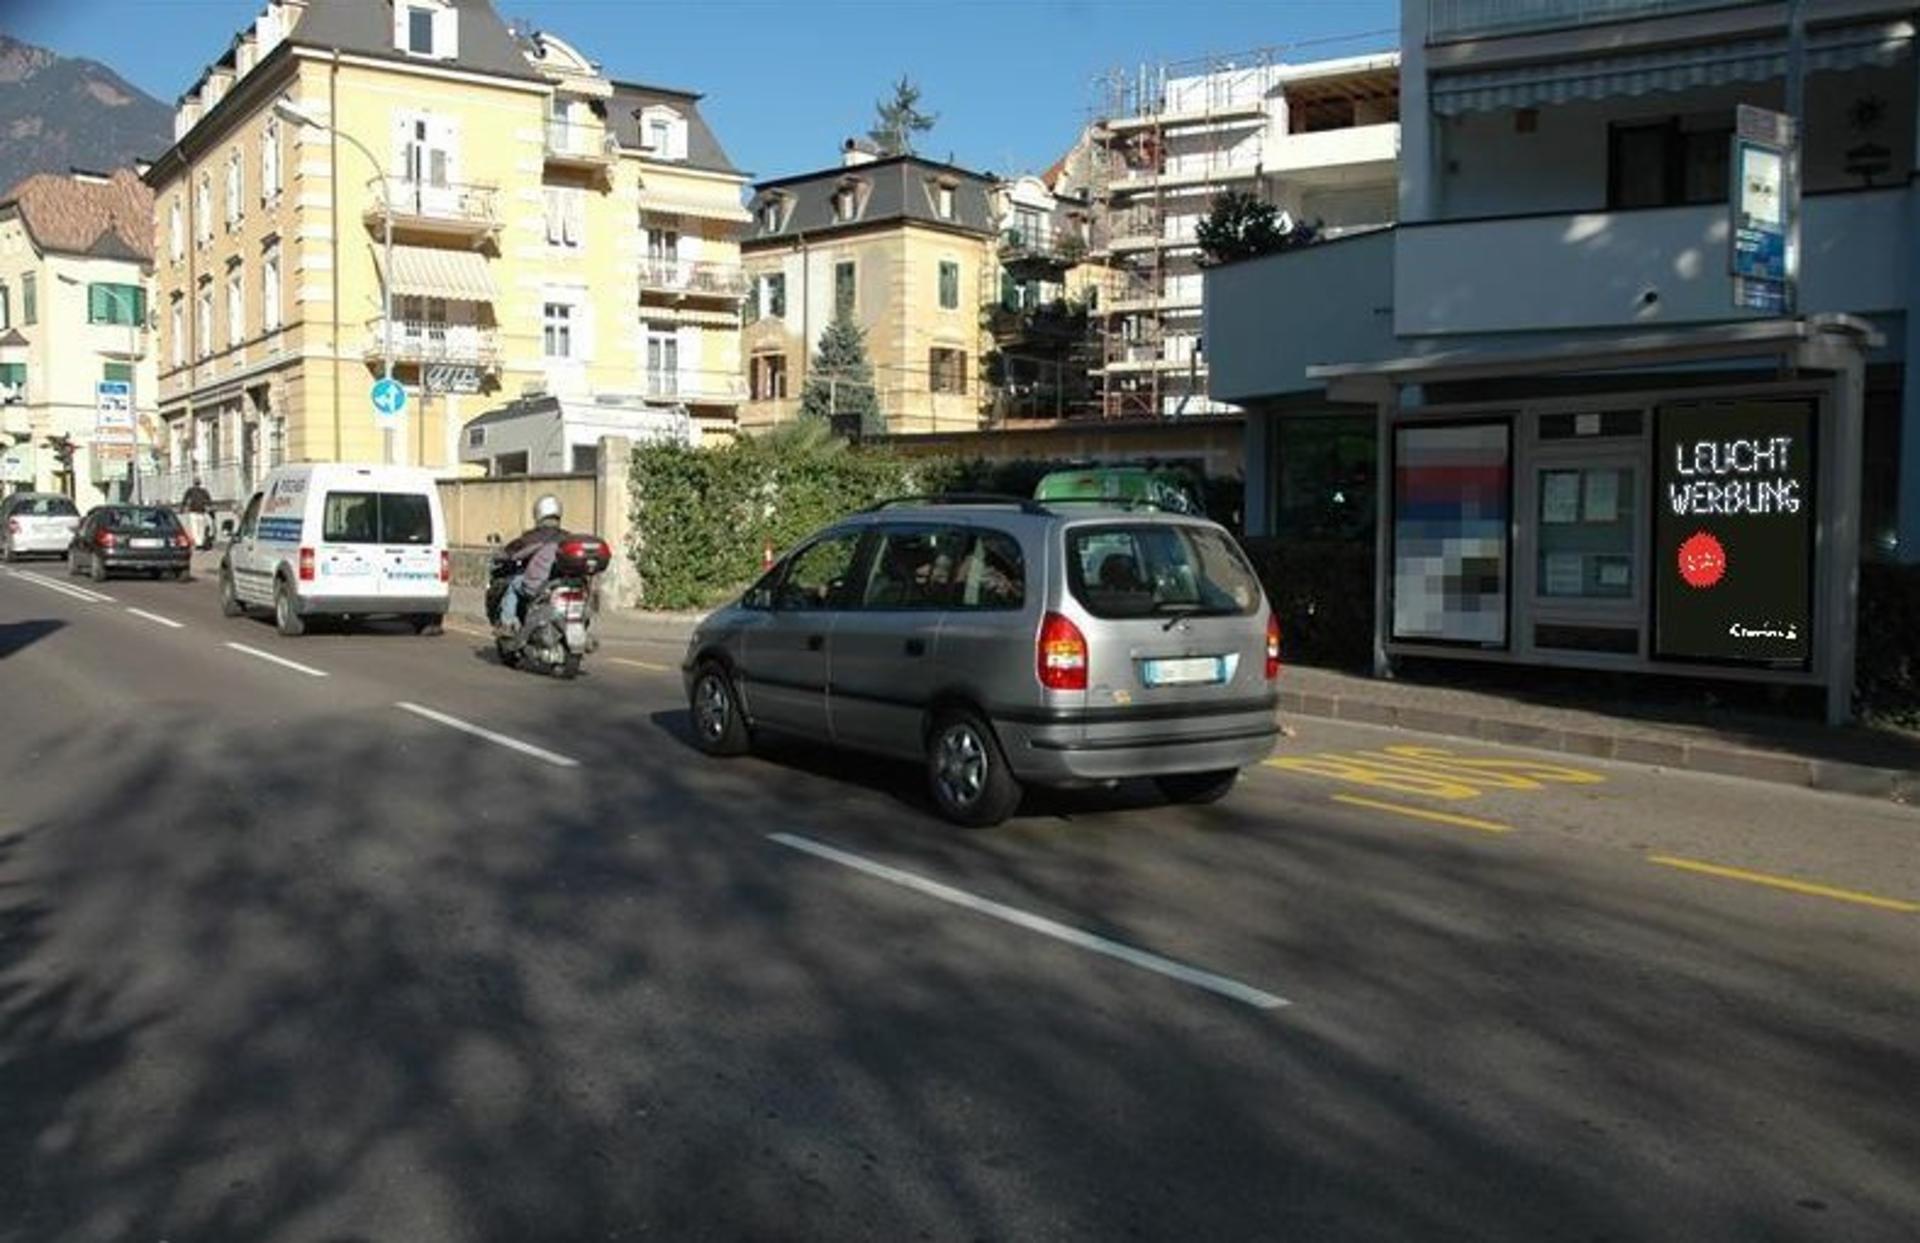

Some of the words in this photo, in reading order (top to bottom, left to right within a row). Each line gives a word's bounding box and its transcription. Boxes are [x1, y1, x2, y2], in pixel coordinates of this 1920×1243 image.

[1676, 438, 1792, 474] LEUCHT
[1669, 478, 1800, 515] WERBUNG
[1260, 745, 1608, 799] BUS
